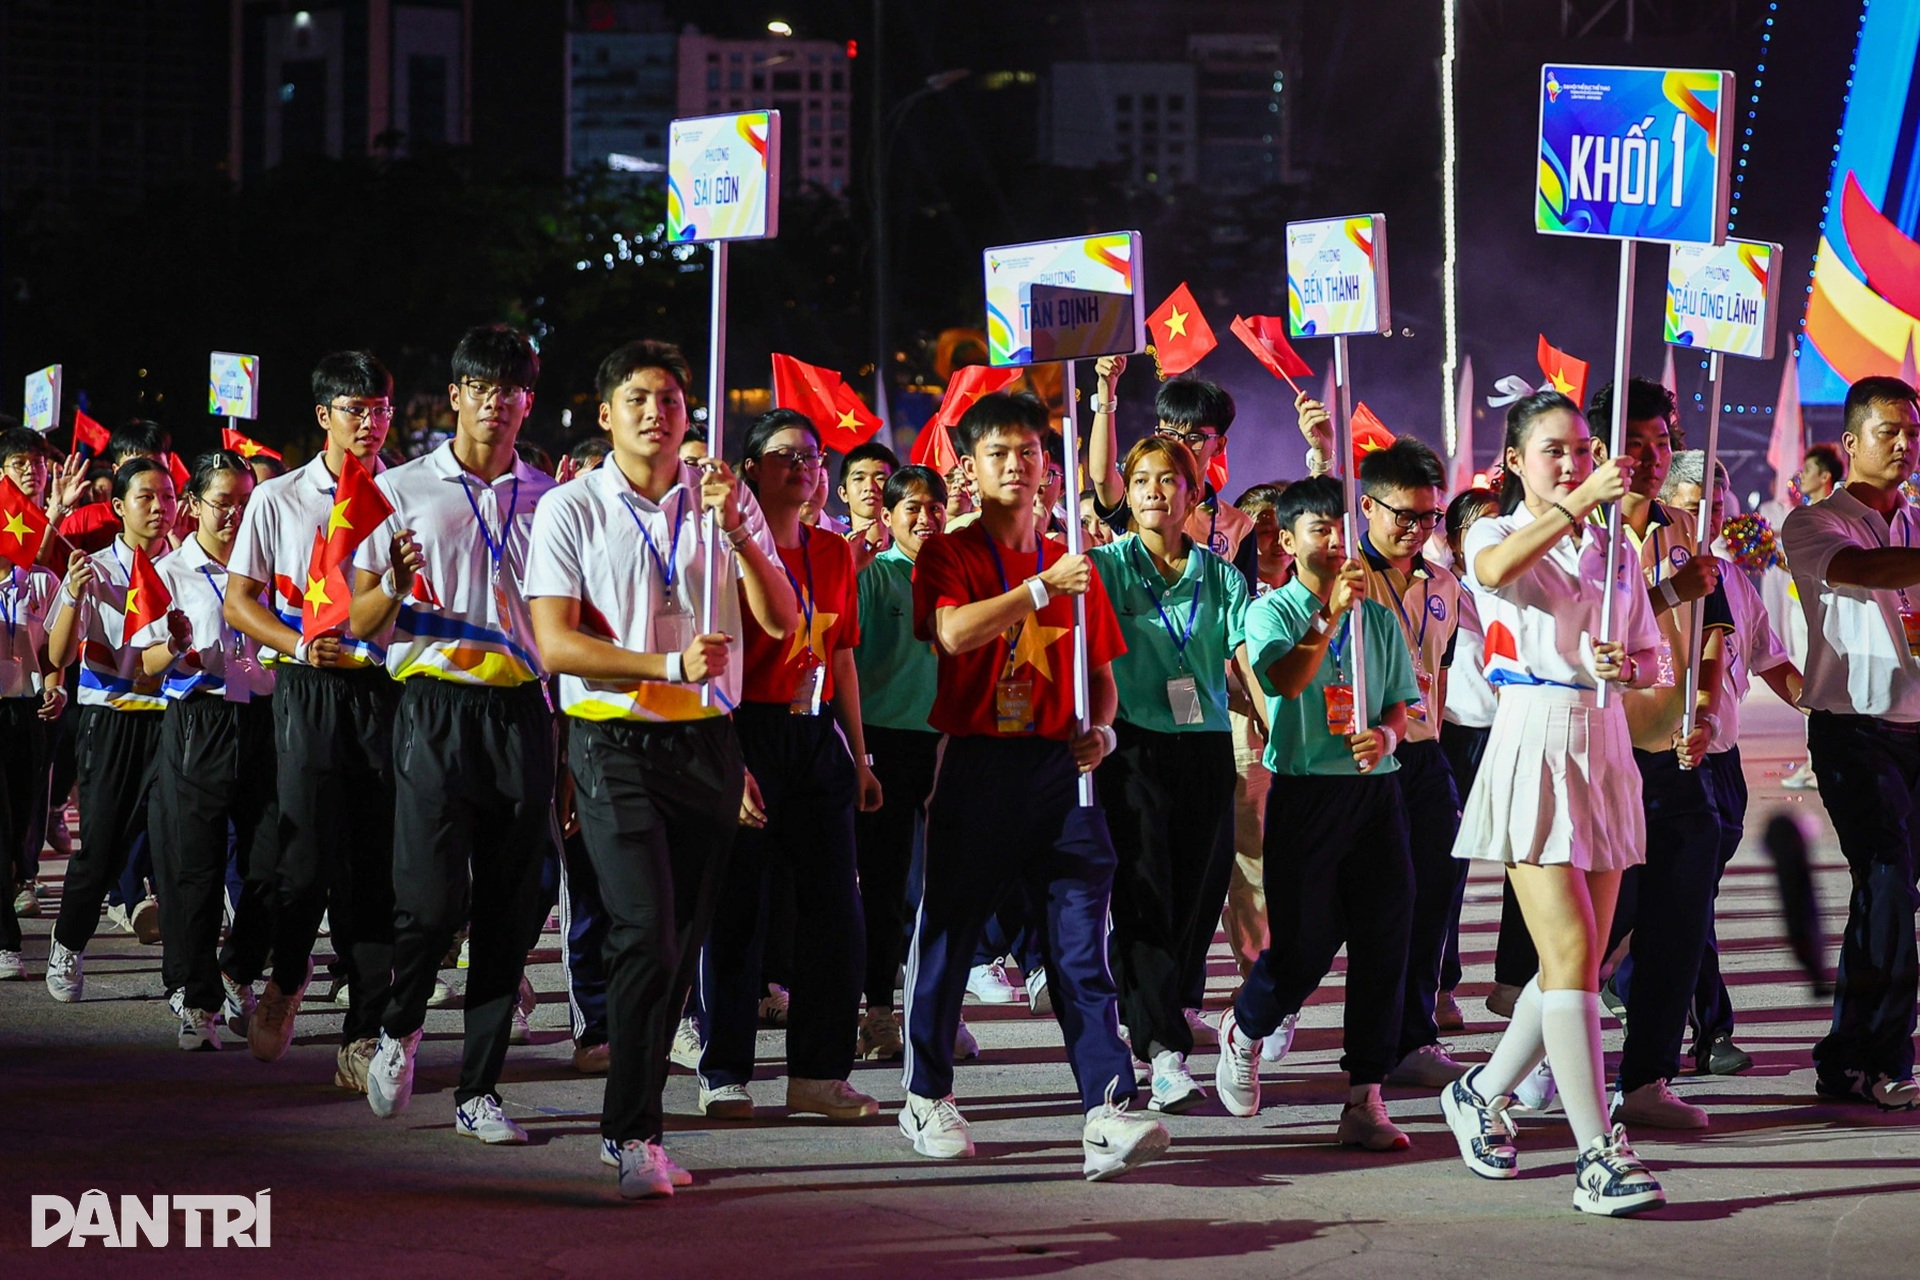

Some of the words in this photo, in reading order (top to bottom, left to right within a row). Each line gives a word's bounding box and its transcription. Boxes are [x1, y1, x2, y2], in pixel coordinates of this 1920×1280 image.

[1569, 116, 1660, 206] KHỐI
[1671, 112, 1687, 208] 1
[694, 172, 712, 206] SÀI
[716, 170, 739, 204] GÒN
[1040, 269, 1076, 286] PHƯỜNG
[1304, 269, 1323, 304] BẾN
[1326, 270, 1360, 302] THÀNH
[1021, 297, 1053, 330] TÂN
[1058, 295, 1099, 331] ĐỊNH
[1674, 281, 1697, 315] CẦU
[1700, 287, 1724, 320] ÔNG
[1727, 293, 1758, 326] LÃNH
